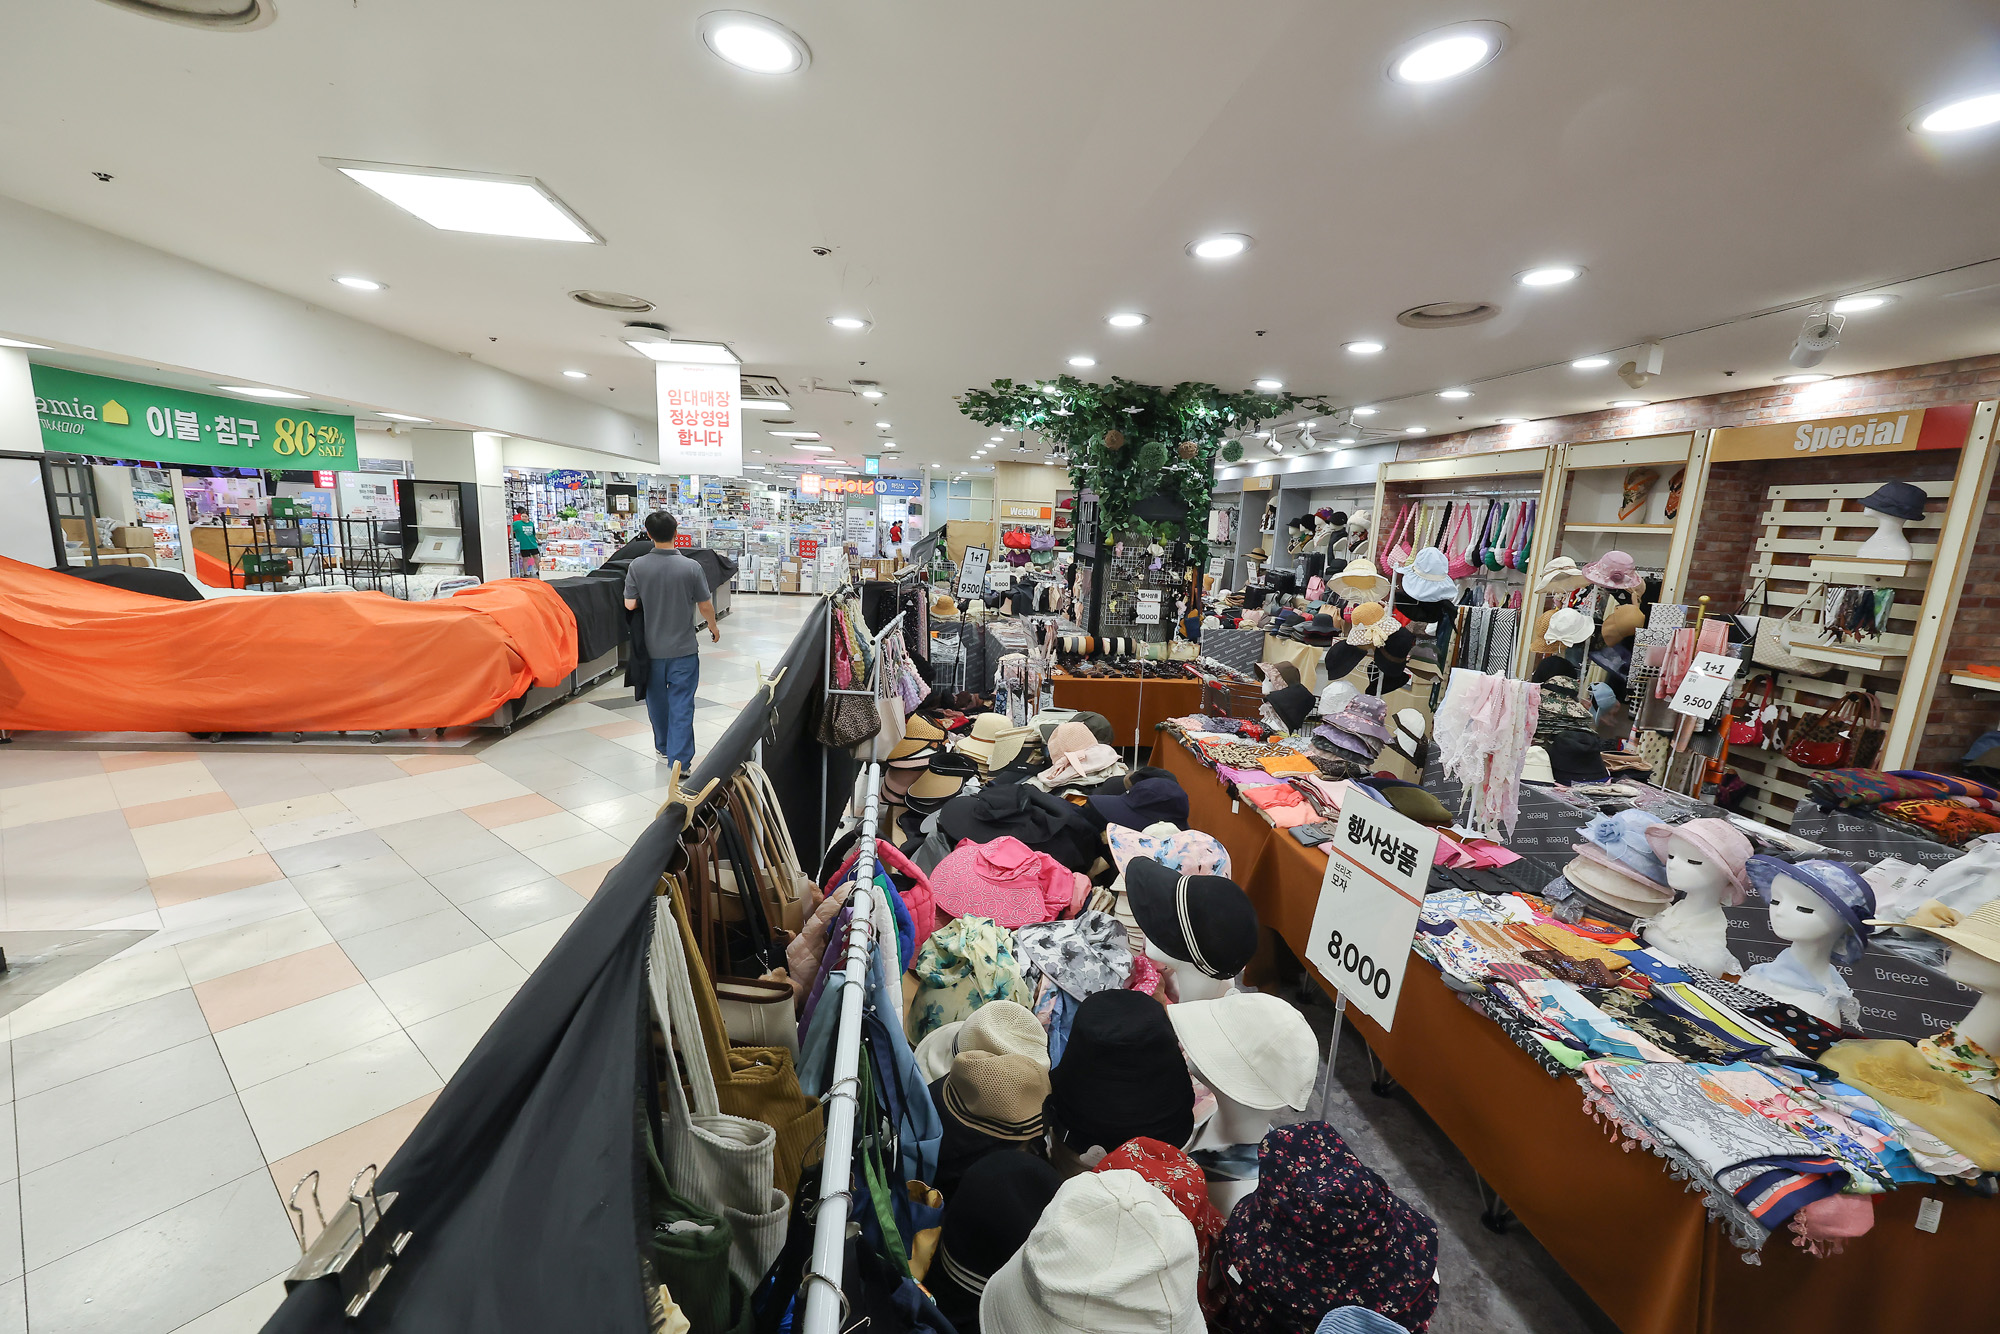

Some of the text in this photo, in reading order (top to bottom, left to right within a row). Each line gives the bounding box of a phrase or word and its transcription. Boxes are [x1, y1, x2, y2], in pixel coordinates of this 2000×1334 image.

[668, 389, 731, 407] 임대매장
[669, 409, 730, 428] 정상영업
[677, 429, 724, 447] 합니다
[1793, 415, 1909, 452] Special
[318, 445, 345, 457] SALE
[824, 479, 875, 496] 다이소
[1010, 507, 1038, 517] Weekly
[970, 551, 984, 563] 1+1
[961, 582, 980, 594] 9,500
[1702, 661, 1725, 675] 1+1
[1682, 694, 1713, 710] 9,500
[1557, 810, 1583, 819] Breeze
[1347, 813, 1418, 878] 행사상품
[1516, 837, 1539, 847] Breeze
[1546, 836, 1570, 845] Breeze
[1917, 850, 1956, 860] Breeze
[1333, 861, 1353, 880] 브리즈
[1330, 873, 1348, 893] 모자
[1327, 930, 1391, 1000] 8,000
[1874, 967, 1929, 987] Breeze
